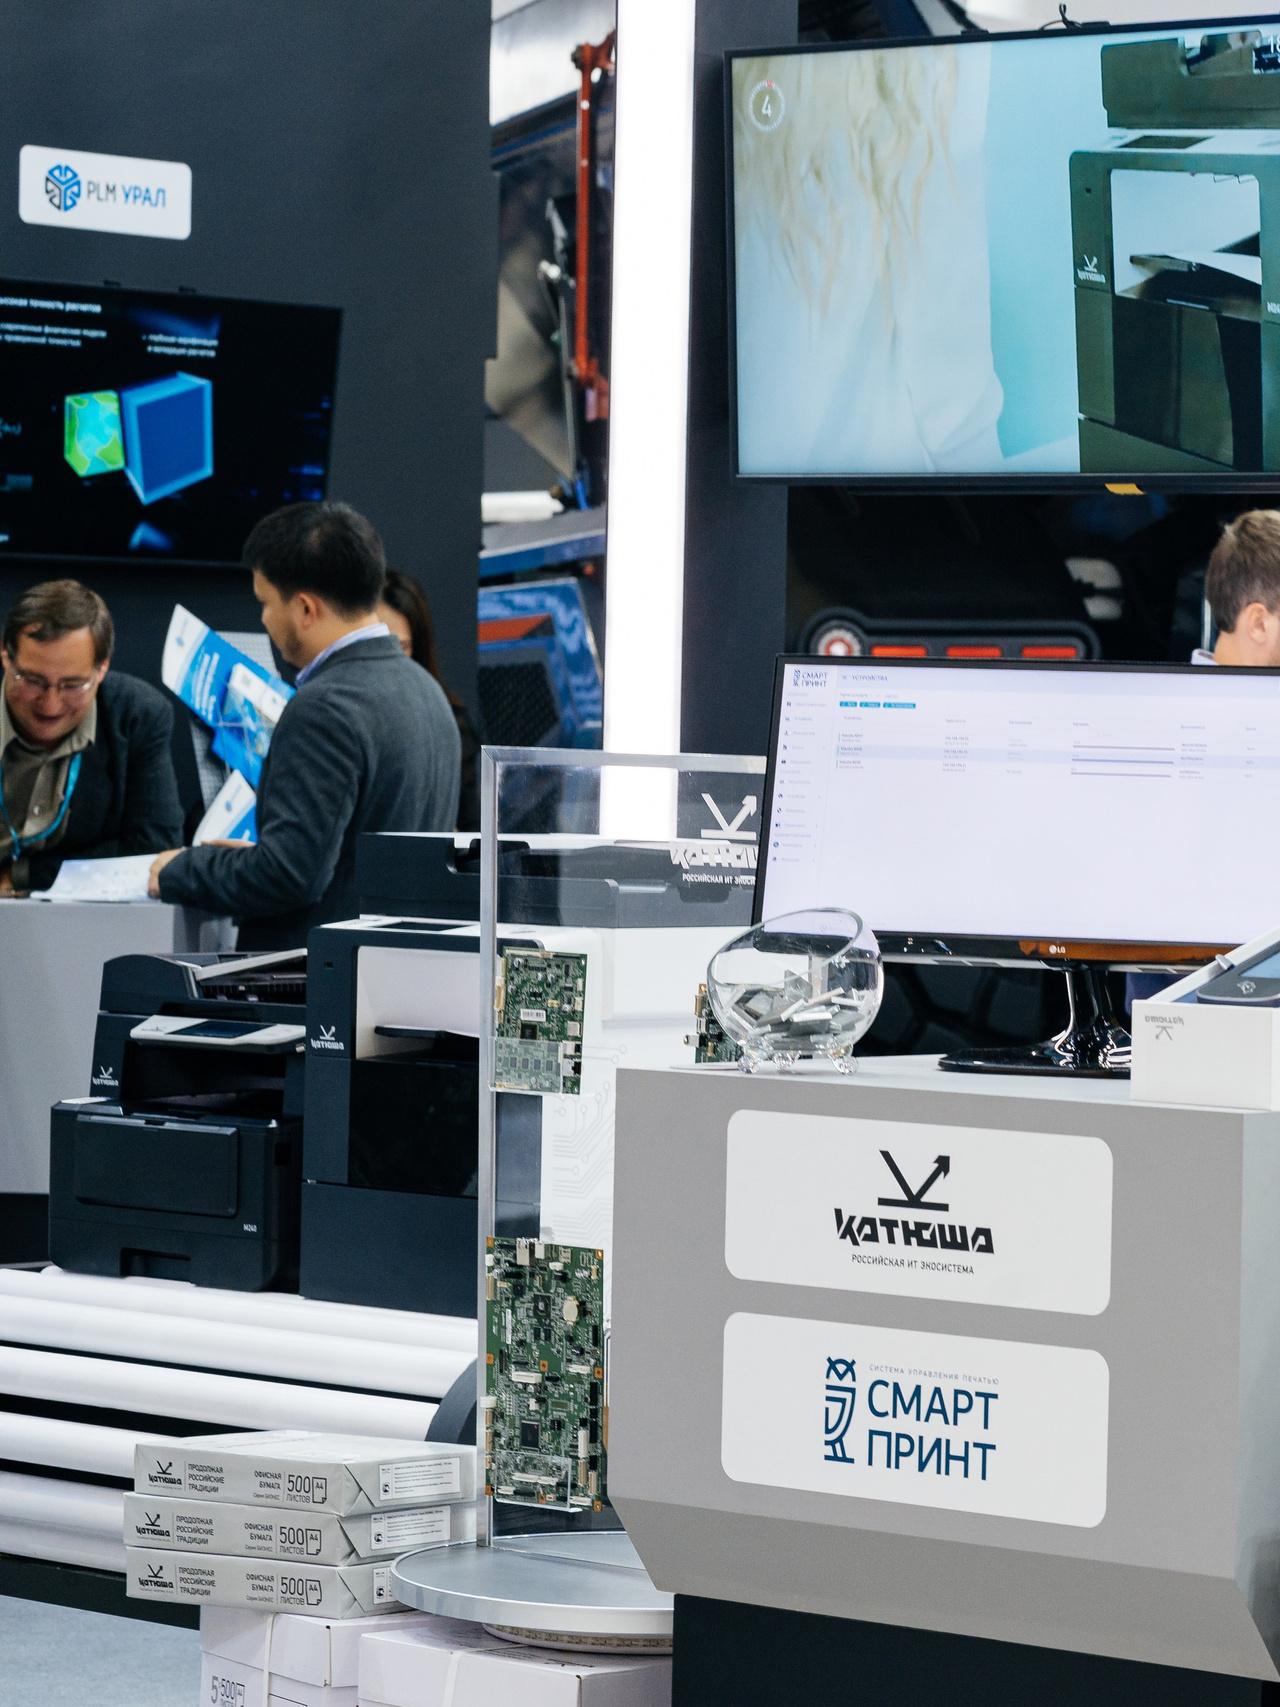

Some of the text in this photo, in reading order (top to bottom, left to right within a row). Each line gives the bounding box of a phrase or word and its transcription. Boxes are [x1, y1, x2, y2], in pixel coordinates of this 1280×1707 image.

[761, 95, 773, 118] 4
[87, 180, 166, 208] PLM УРАЛ
[682, 873, 724, 884] РОССИЙСКАЯ
[724, 875, 734, 885] ИТ
[851, 1254, 974, 1274] РОССИЙСКАЯ ИТ ЭКОСИСТЕМА
[869, 1363, 1000, 1385] СИСТЕМА УПРАВЛЕНИЯ ПЕЧАТЬЮ
[867, 1379, 999, 1430] СМАРТ
[867, 1429, 997, 1481] ПРИНТ
[188, 1463, 223, 1474] ПРОДОЛЖАЯ
[188, 1473, 225, 1484] РОССИЙСКИЕ
[254, 1470, 282, 1480] ОФИСНАЯ
[188, 1483, 219, 1494] ТРАДИЦИИ
[259, 1481, 281, 1490] БУМАГА
[287, 1474, 311, 1494] 500
[286, 1493, 311, 1504] ЛИСТОВ
[176, 1515, 213, 1526] ПРОДОЛЖАЯ
[176, 1525, 214, 1536] РОССИЙСКИЕ
[244, 1522, 273, 1532] ОФИСНАЯ
[176, 1535, 209, 1545] ТРАДИЦИИ
[249, 1532, 273, 1542] БУМАГА
[279, 1526, 304, 1546] 500
[279, 1545, 305, 1555] ЛИСТОВ
[179, 1566, 215, 1577] ПРОДОЛЖАЯ
[179, 1576, 216, 1587] РОССИЙСКИЕ
[246, 1573, 275, 1582] ОФИСНАЯ
[251, 1583, 274, 1593] БУМАГА
[280, 1576, 304, 1595] 500
[180, 1586, 211, 1597] ТРАДИЦИИ
[280, 1595, 305, 1606] ЛИСТОВ
[211, 1675, 236, 1704] 5 500
